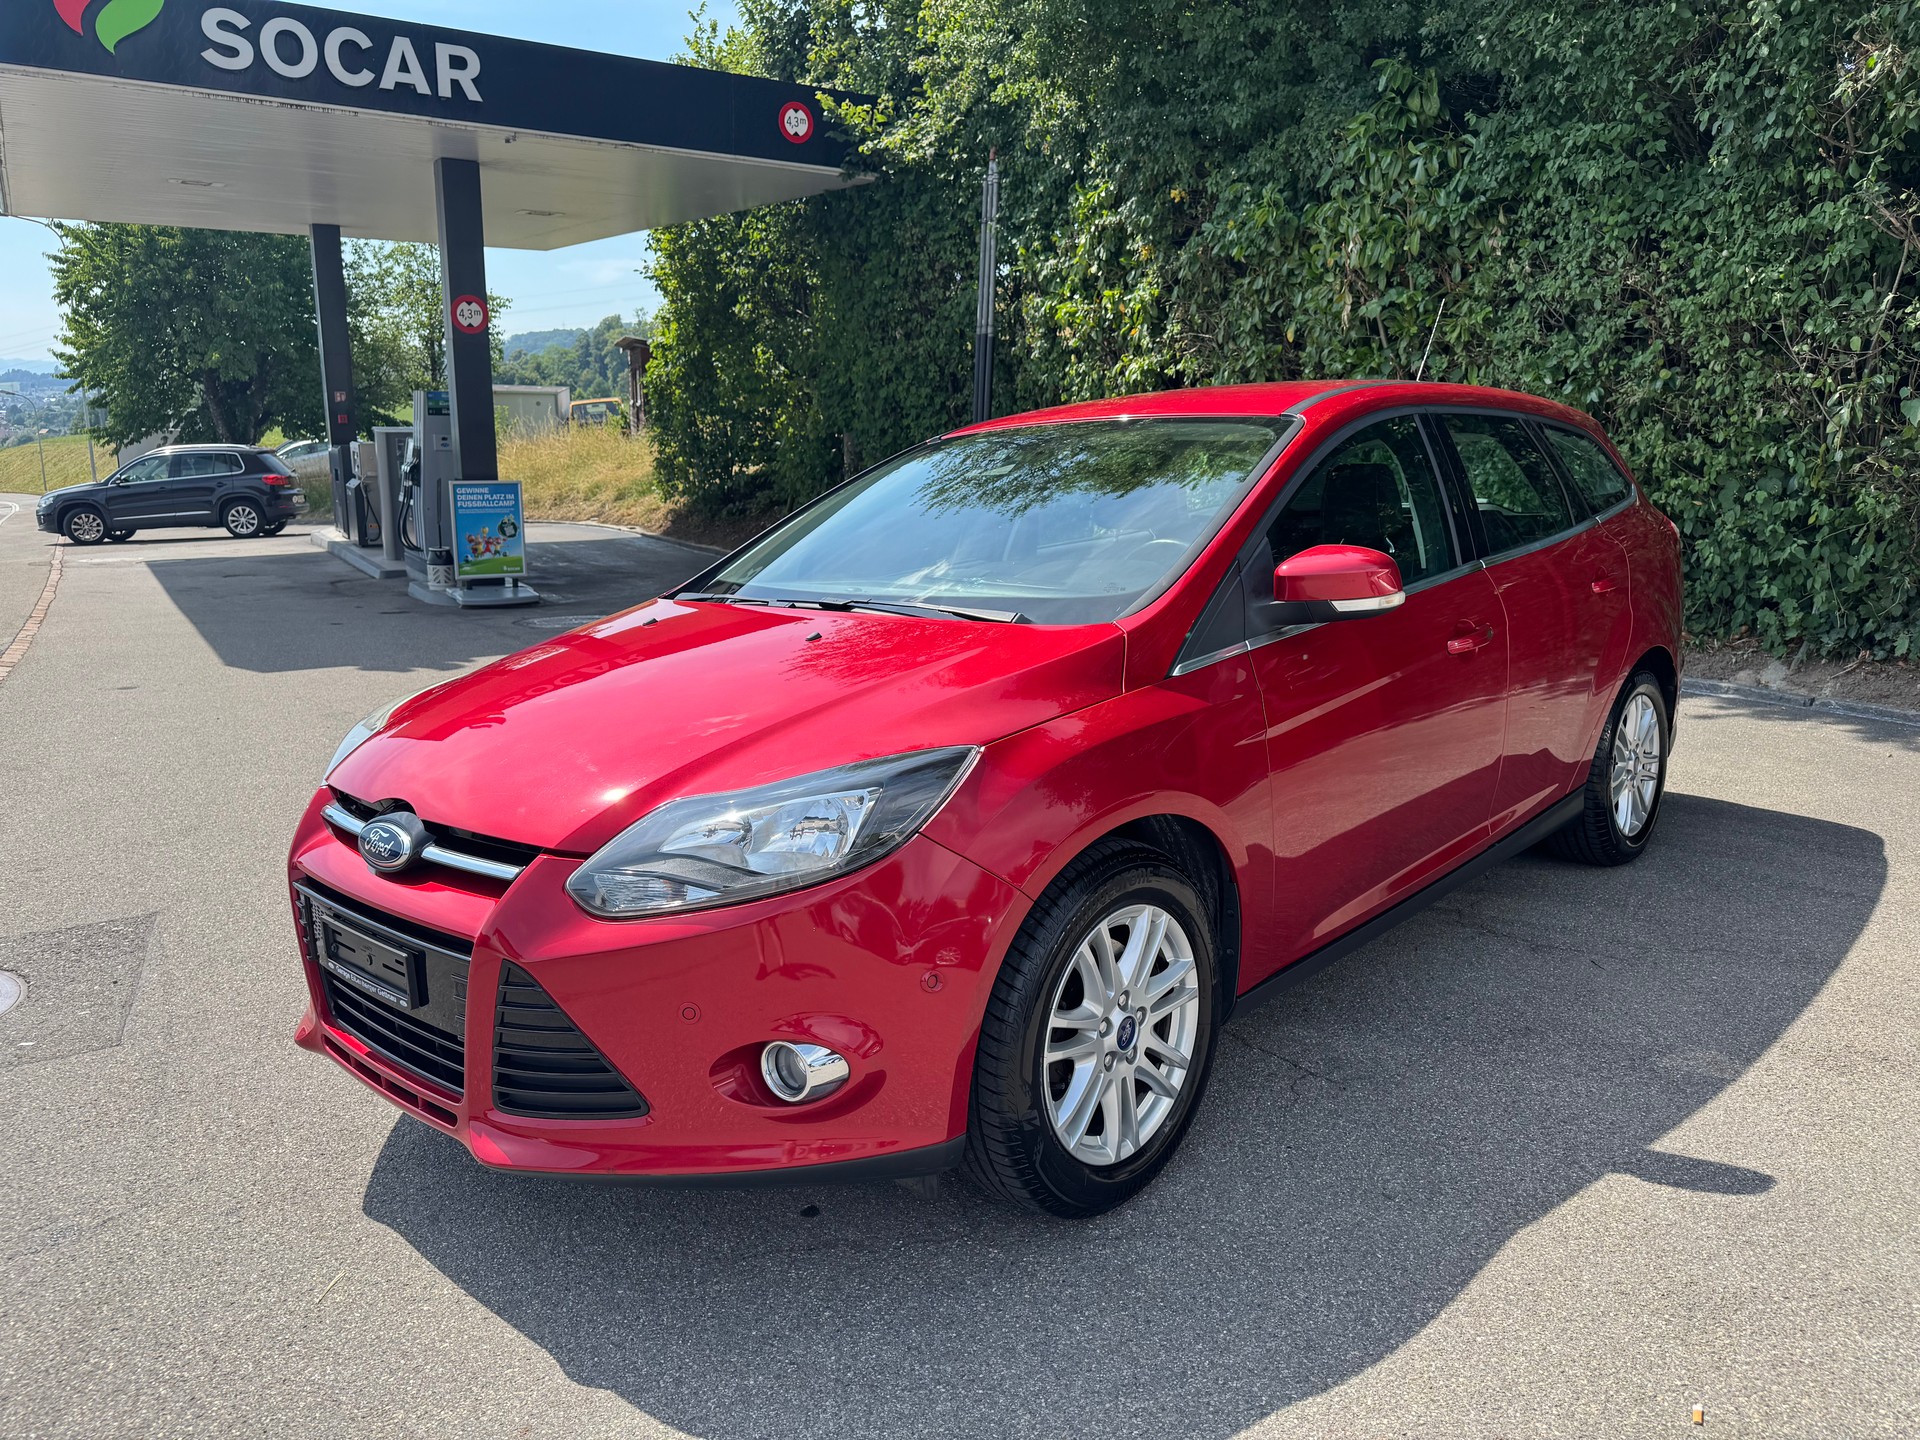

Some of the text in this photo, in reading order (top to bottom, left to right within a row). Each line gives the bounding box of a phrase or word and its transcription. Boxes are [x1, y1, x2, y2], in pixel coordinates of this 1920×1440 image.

[200, 7, 484, 102] SOCAR
[457, 500, 515, 508] FUSSBALLCAMP
[364, 828, 395, 858] Ford
